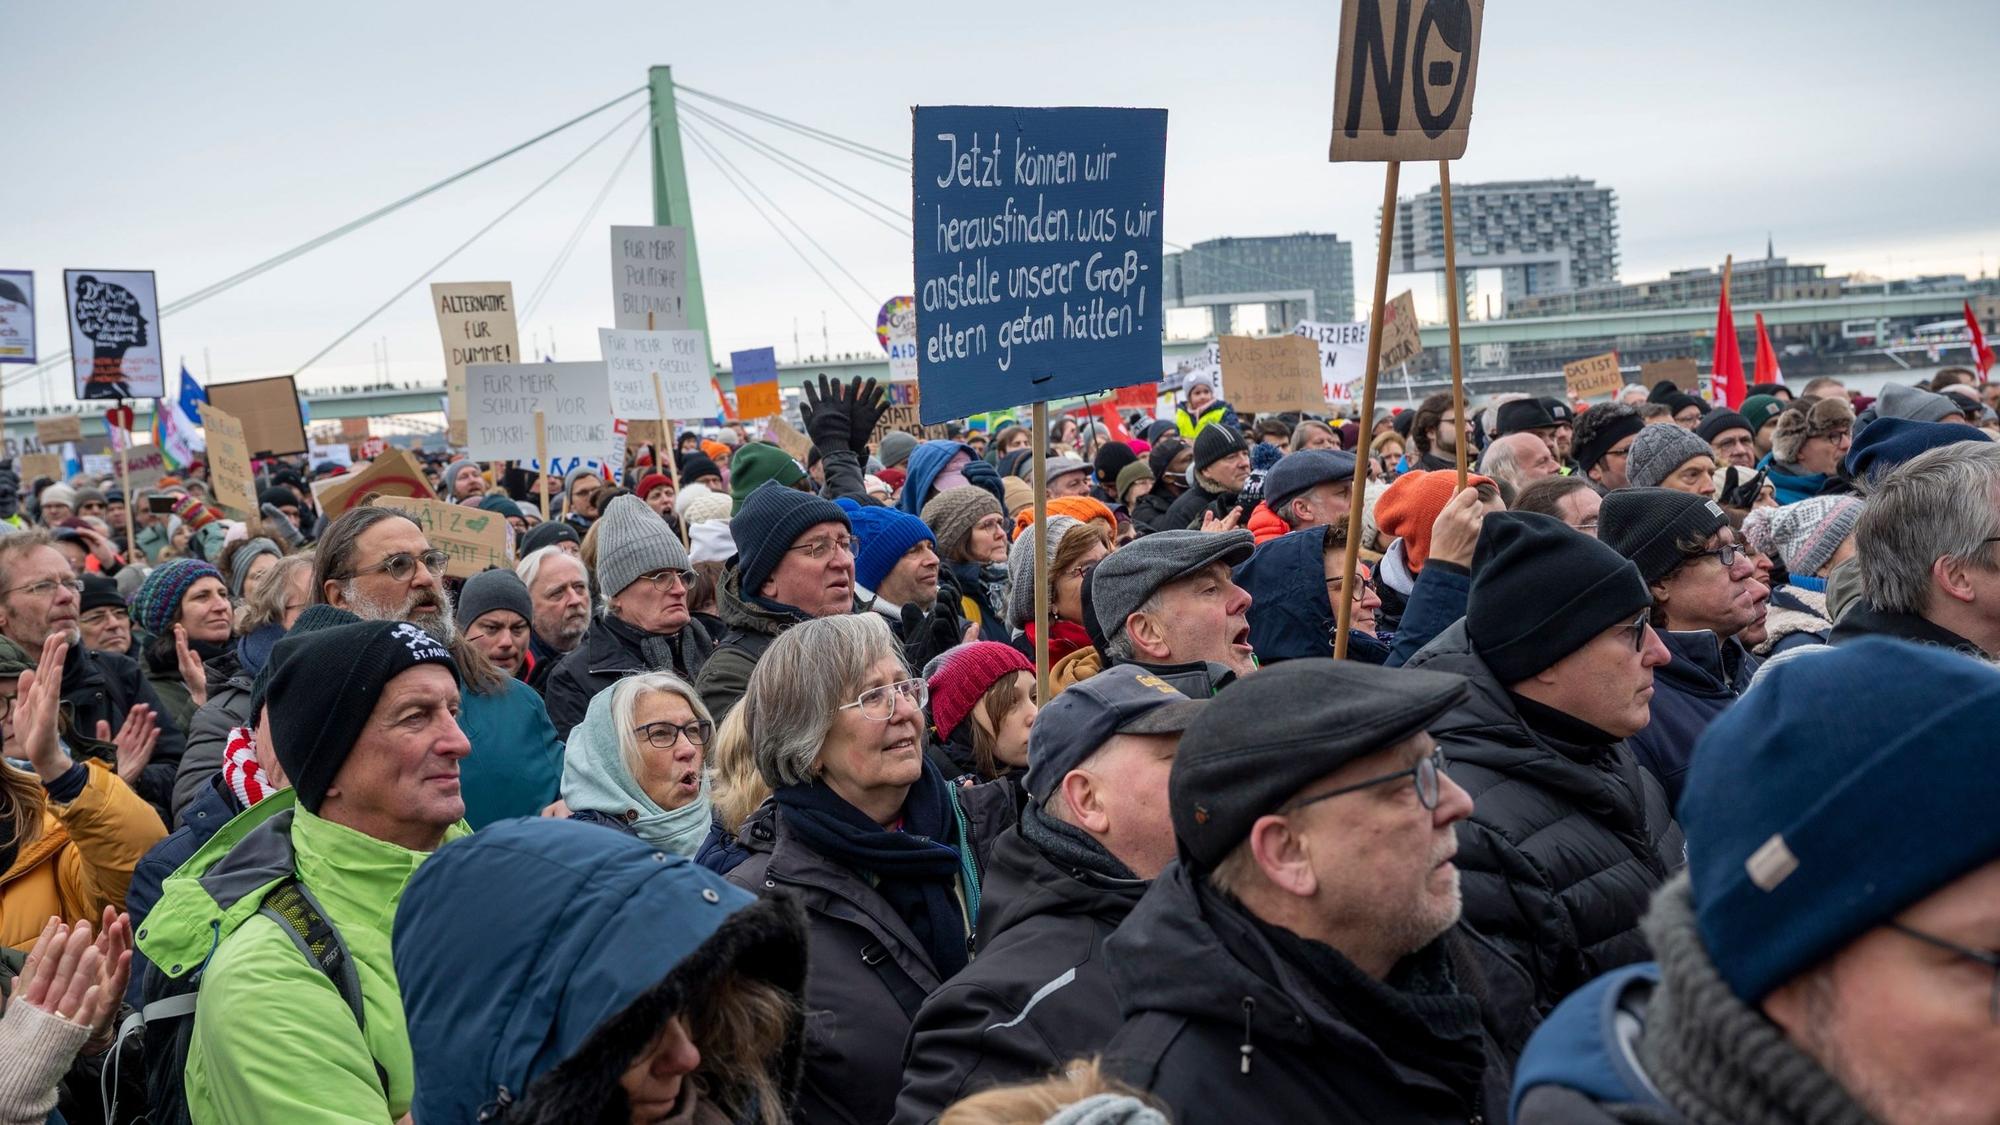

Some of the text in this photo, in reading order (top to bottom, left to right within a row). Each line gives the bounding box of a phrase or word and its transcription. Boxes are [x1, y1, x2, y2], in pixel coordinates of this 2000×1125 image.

[937, 132, 1117, 188] Jetzt können wir
[1078, 208, 1117, 242] was
[1125, 202, 1157, 238] wir
[923, 250, 1149, 312] anstelle unserer Groß-
[928, 322, 986, 363] eltern
[998, 306, 1054, 371] getan
[1063, 286, 1146, 340] hätten!
[452, 344, 511, 366] DUMME!
[520, 374, 558, 394] MEHR
[482, 397, 586, 415] SCHUTZ VOR
